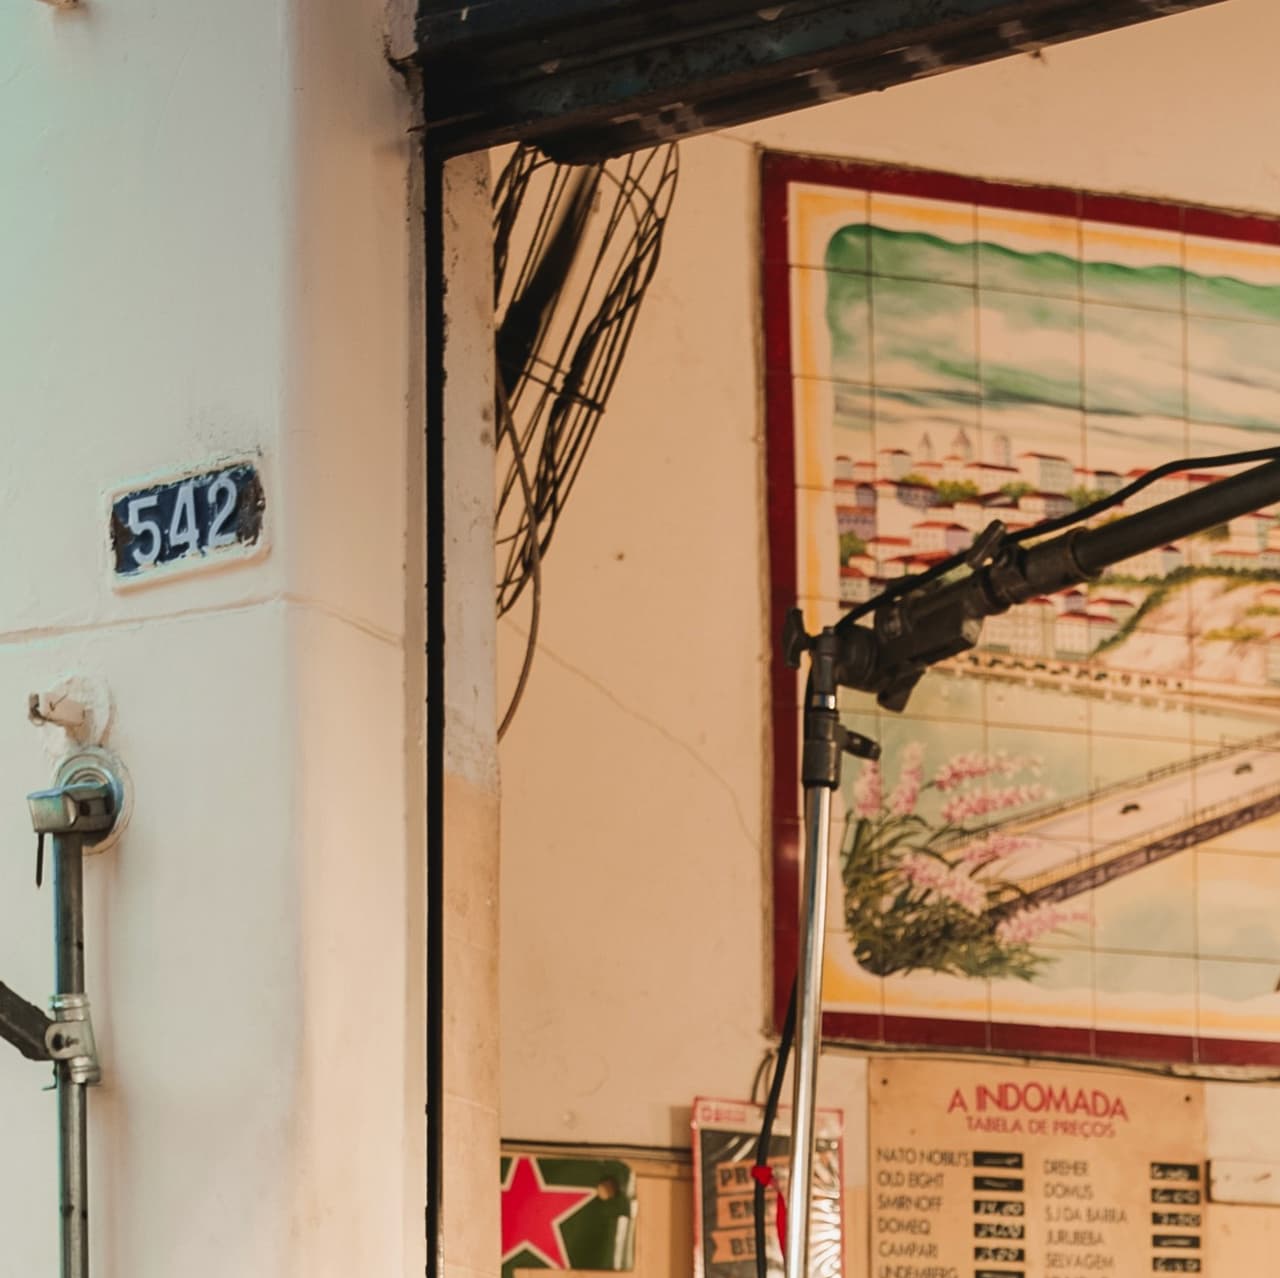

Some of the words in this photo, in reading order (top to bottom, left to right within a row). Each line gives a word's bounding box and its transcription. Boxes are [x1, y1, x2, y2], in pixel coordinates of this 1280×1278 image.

[127, 472, 239, 567] 542
[947, 1088, 968, 1113] A
[976, 1082, 1129, 1122] INDOMADA
[966, 1116, 1022, 1133] TABELA
[1028, 1119, 1047, 1134] DE
[1053, 1120, 1116, 1139] PREÇOS
[1044, 1160, 1088, 1176] DREHER
[878, 1171, 906, 1186] OLD
[909, 1171, 944, 1188] EIGHT
[1044, 1182, 1093, 1200] DOMUS
[878, 1194, 943, 1211] SMIRNOFF
[1086, 1208, 1128, 1224] BARRA
[878, 1217, 930, 1235] DOMEQ
[1048, 1229, 1104, 1246] JURUBEBA
[879, 1241, 938, 1258] CAMPARI
[1046, 1253, 1115, 1269] SELVAGEM
